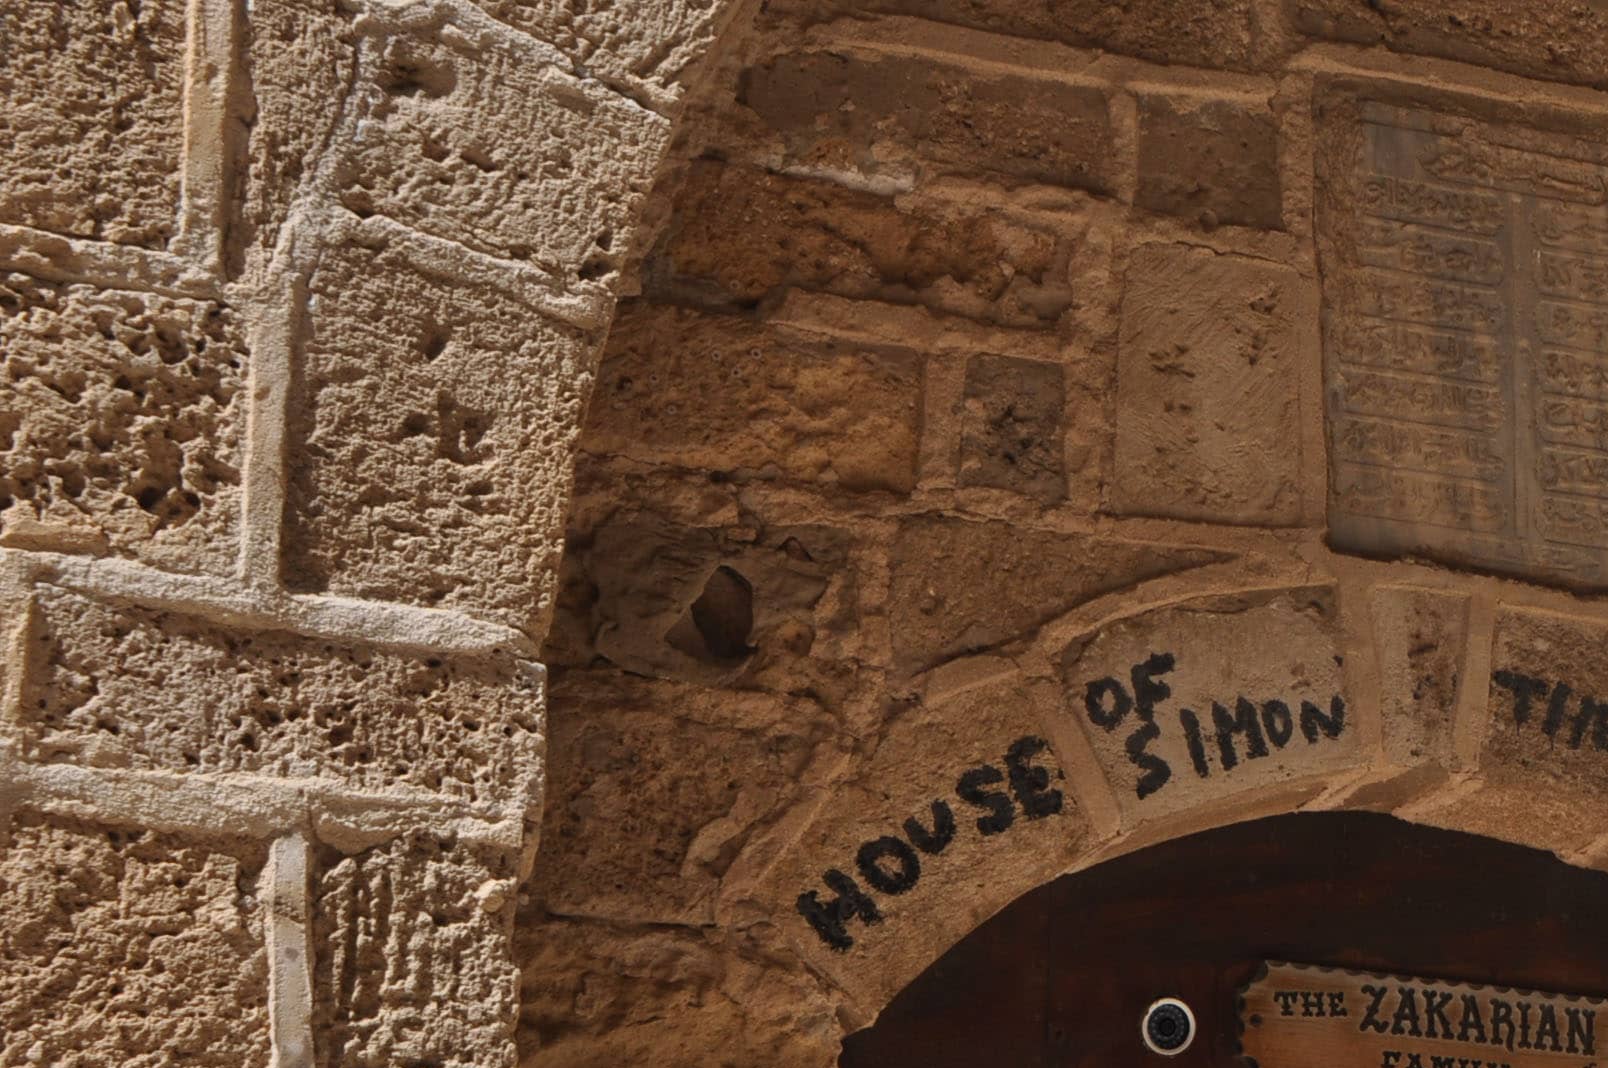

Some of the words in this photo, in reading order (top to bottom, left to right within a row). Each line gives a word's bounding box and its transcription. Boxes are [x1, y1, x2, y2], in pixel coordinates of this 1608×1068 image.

[1085, 652, 1175, 724] OF
[1124, 695, 1346, 800] SIMON
[798, 735, 1066, 952] HOUSE
[1274, 990, 1348, 1018] THE
[1360, 985, 1597, 1056] ZAKARIAN
